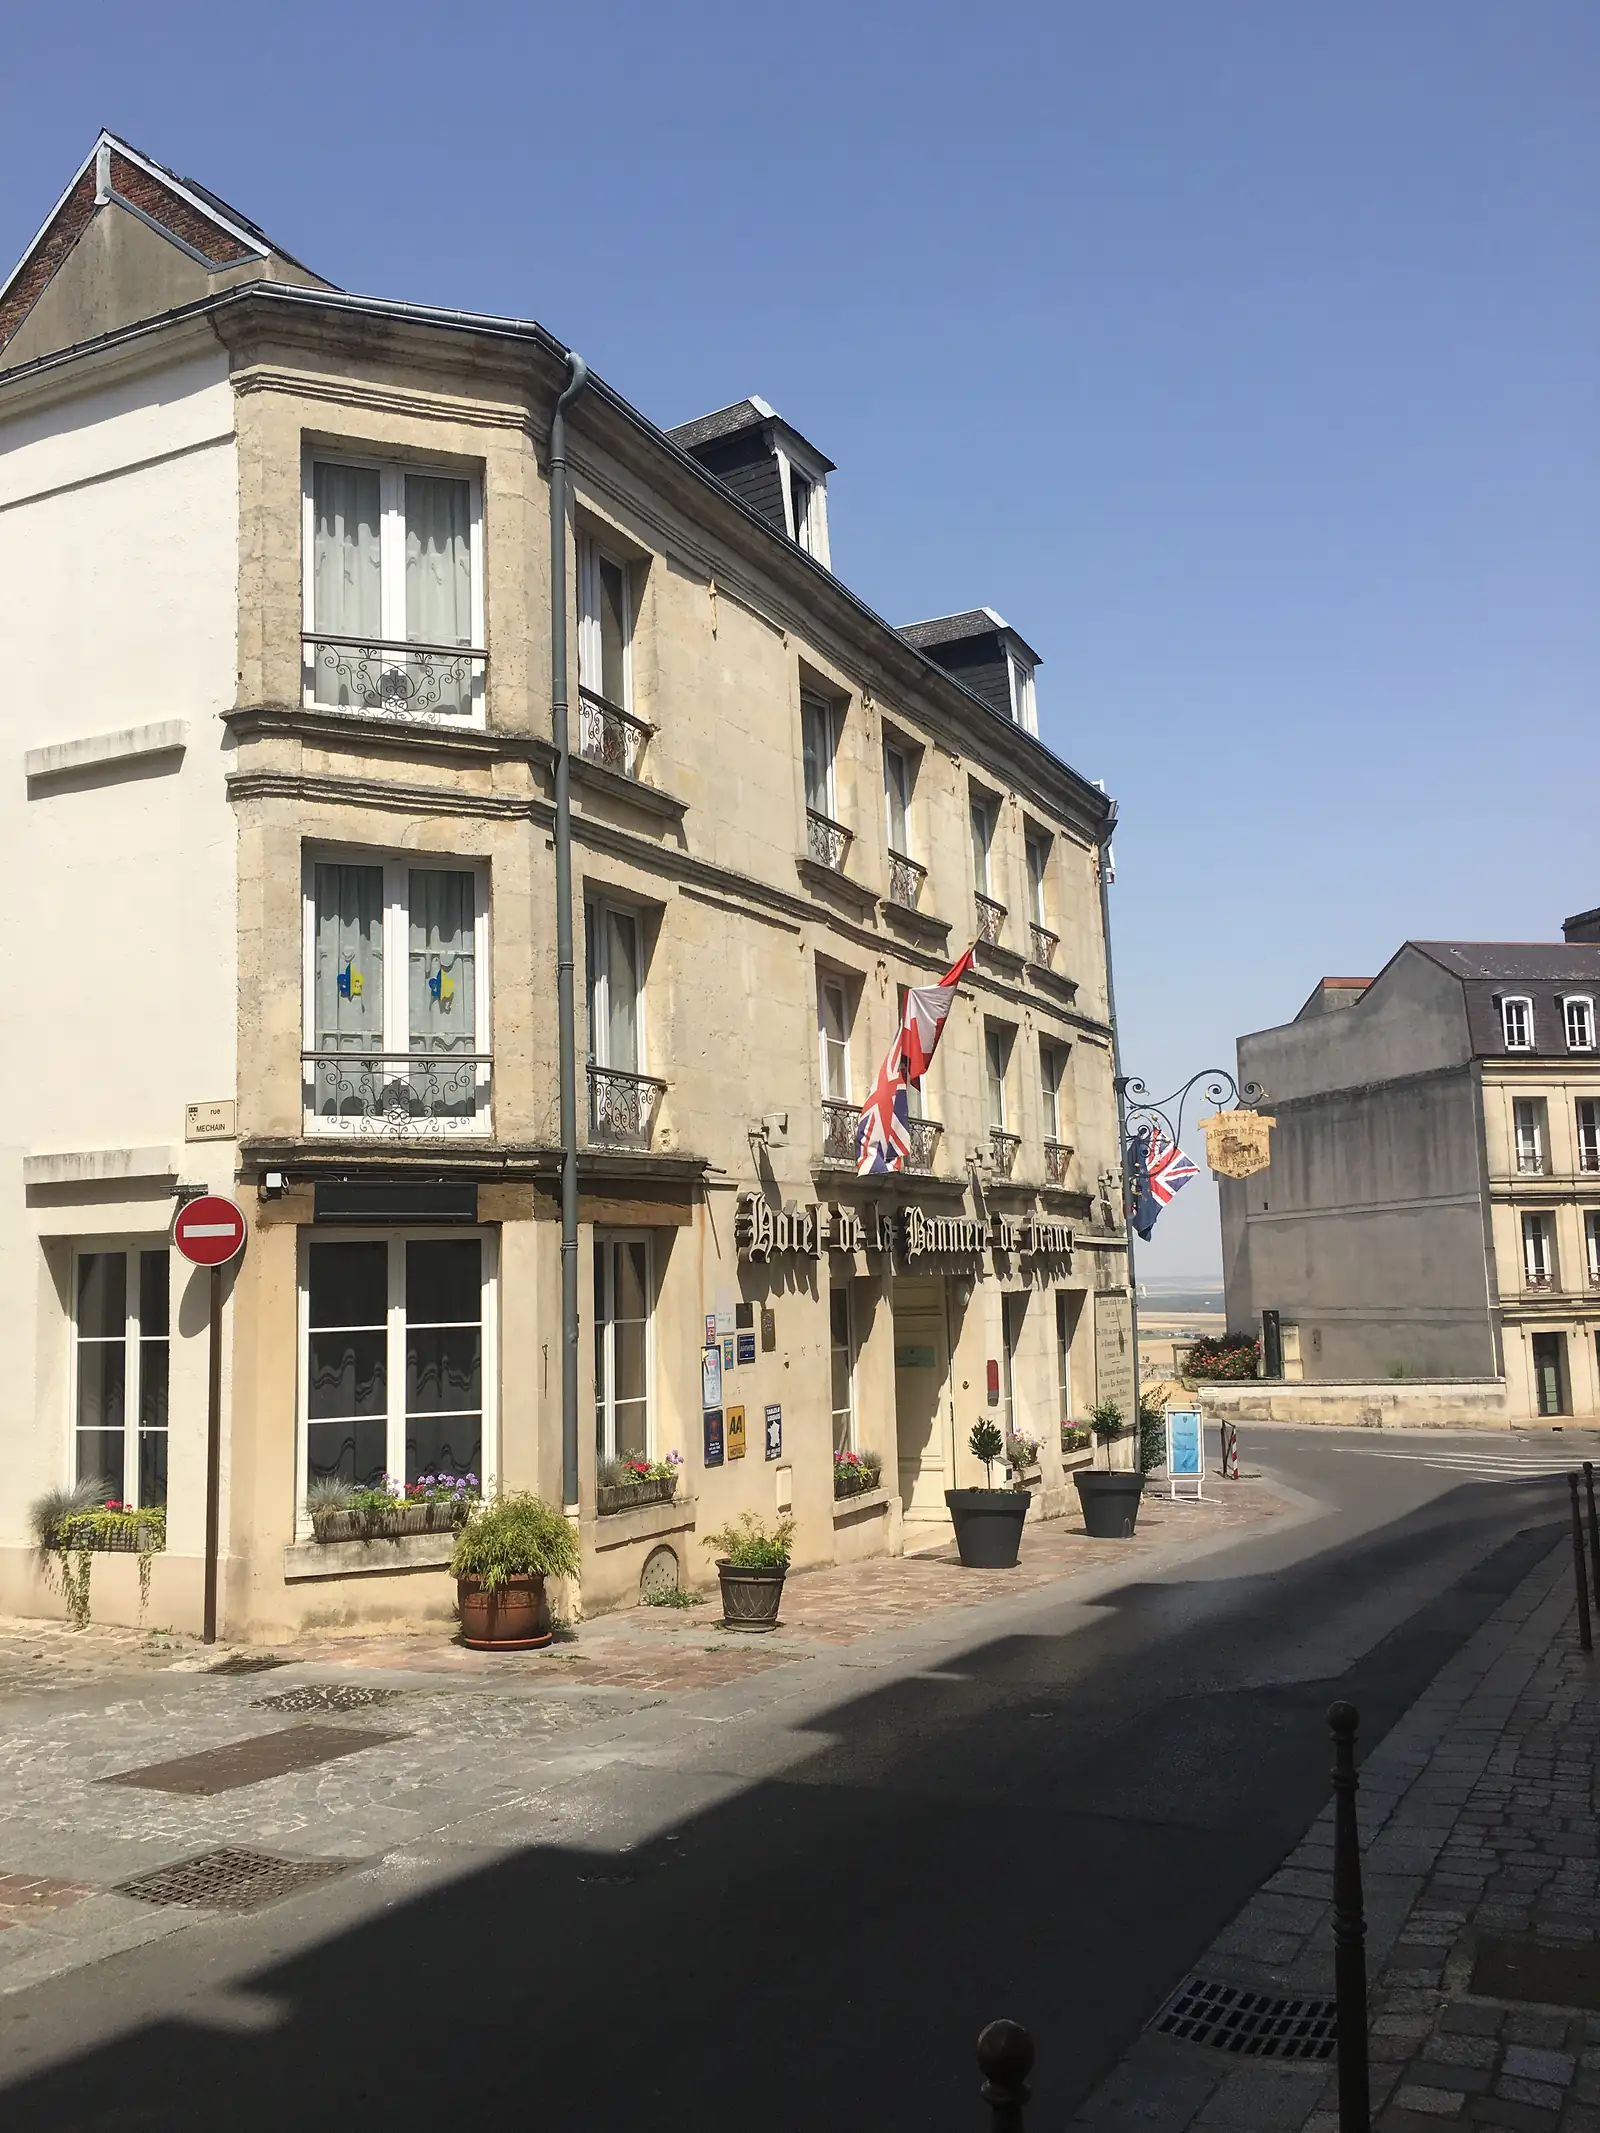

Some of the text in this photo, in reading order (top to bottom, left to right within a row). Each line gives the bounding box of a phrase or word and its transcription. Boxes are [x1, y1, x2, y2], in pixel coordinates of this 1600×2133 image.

[196, 1123, 226, 1132] MECHAIN
[1240, 1125, 1248, 1134] de
[829, 1201, 863, 1253] de
[867, 1199, 896, 1252] la
[993, 1211, 1018, 1252] de
[729, 1415, 743, 1435] AA
